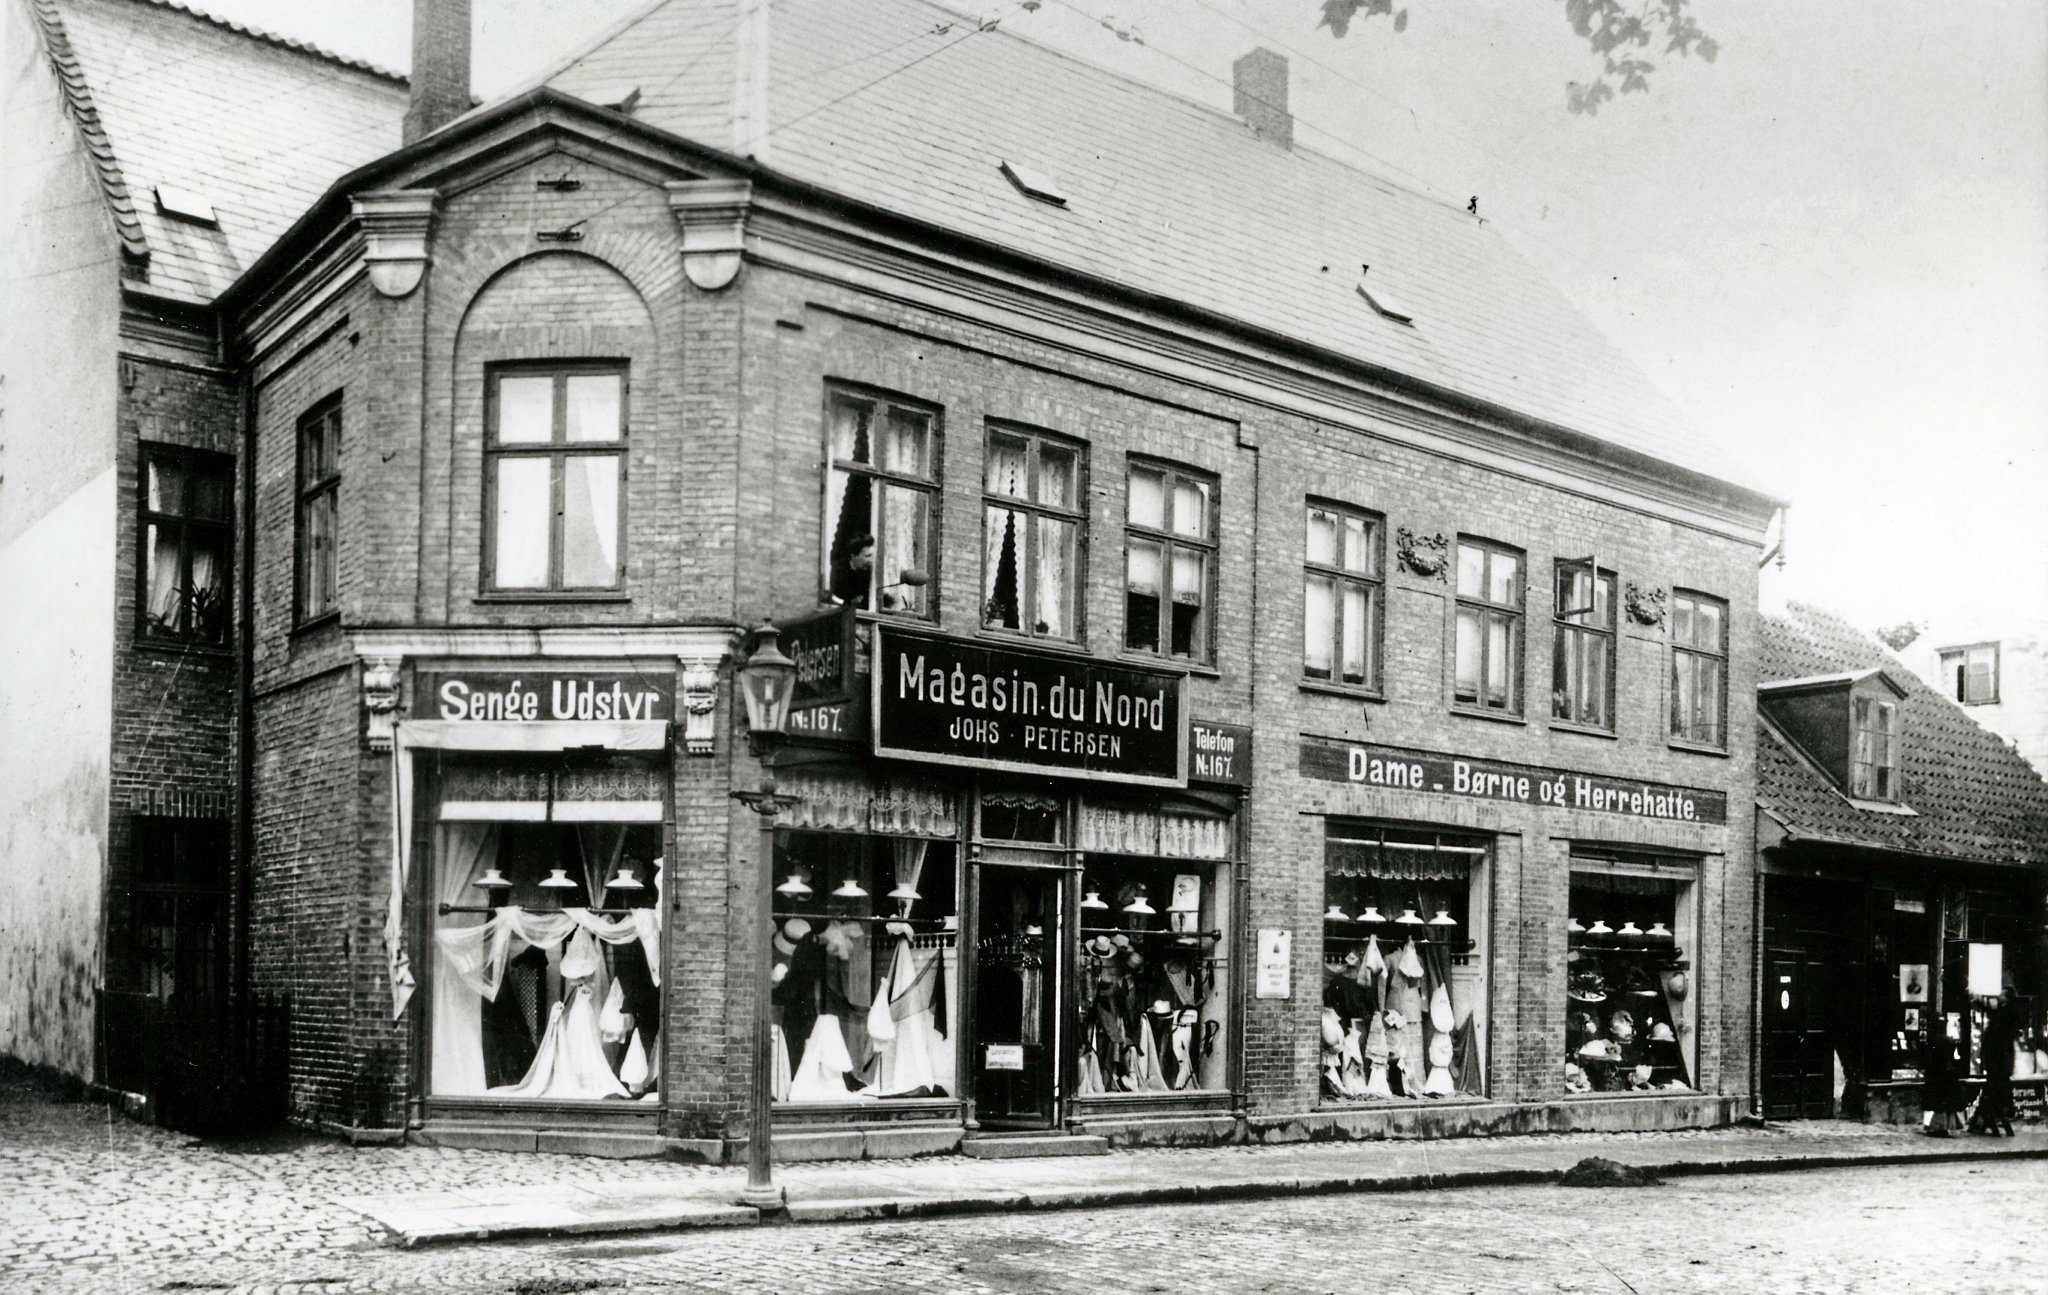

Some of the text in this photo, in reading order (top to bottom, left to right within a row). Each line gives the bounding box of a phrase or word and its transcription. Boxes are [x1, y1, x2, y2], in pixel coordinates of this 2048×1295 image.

[440, 679, 660, 721] Senge Udstyr
[1049, 675, 1085, 722] du
[1095, 680, 1165, 732] Nord
[949, 716, 1000, 744] JOHS
[1024, 724, 1121, 759] PETERSEN
[1193, 727, 1235, 753] Telefon
[1348, 747, 1424, 789] Dame
[1453, 760, 1530, 800] Børne
[1539, 775, 1567, 808] og
[1575, 777, 1701, 822] Herrehatte.
